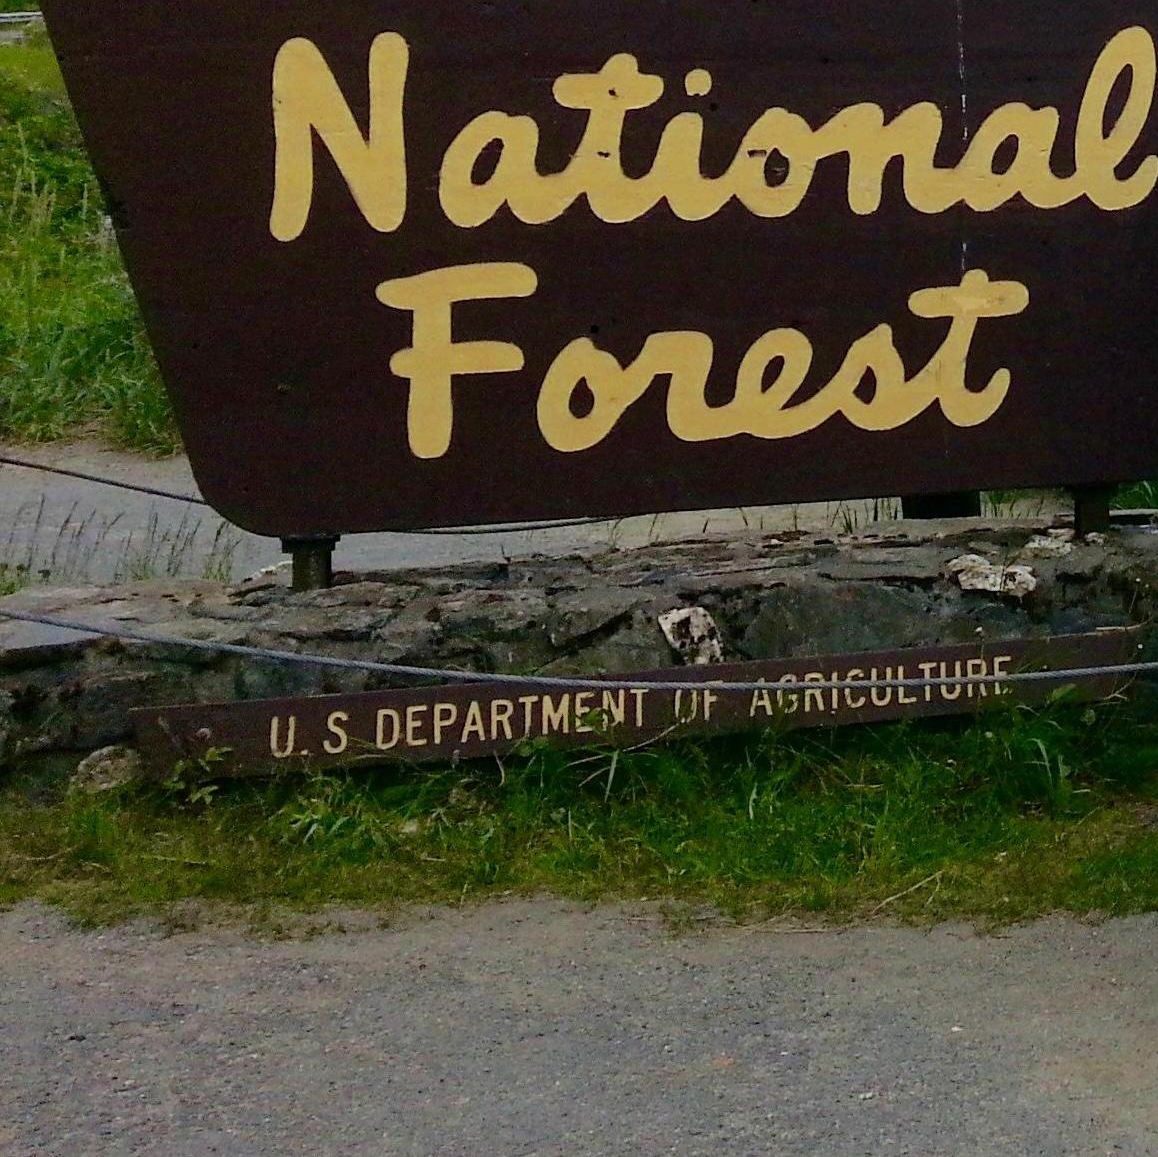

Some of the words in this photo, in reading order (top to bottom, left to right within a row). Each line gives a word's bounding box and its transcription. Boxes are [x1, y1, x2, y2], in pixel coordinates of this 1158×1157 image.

[375, 261, 1029, 461] Forest
[375, 688, 650, 750] DEPARTMENT
[673, 680, 723, 724] OF
[749, 655, 1013, 718] AGRICULTURE
